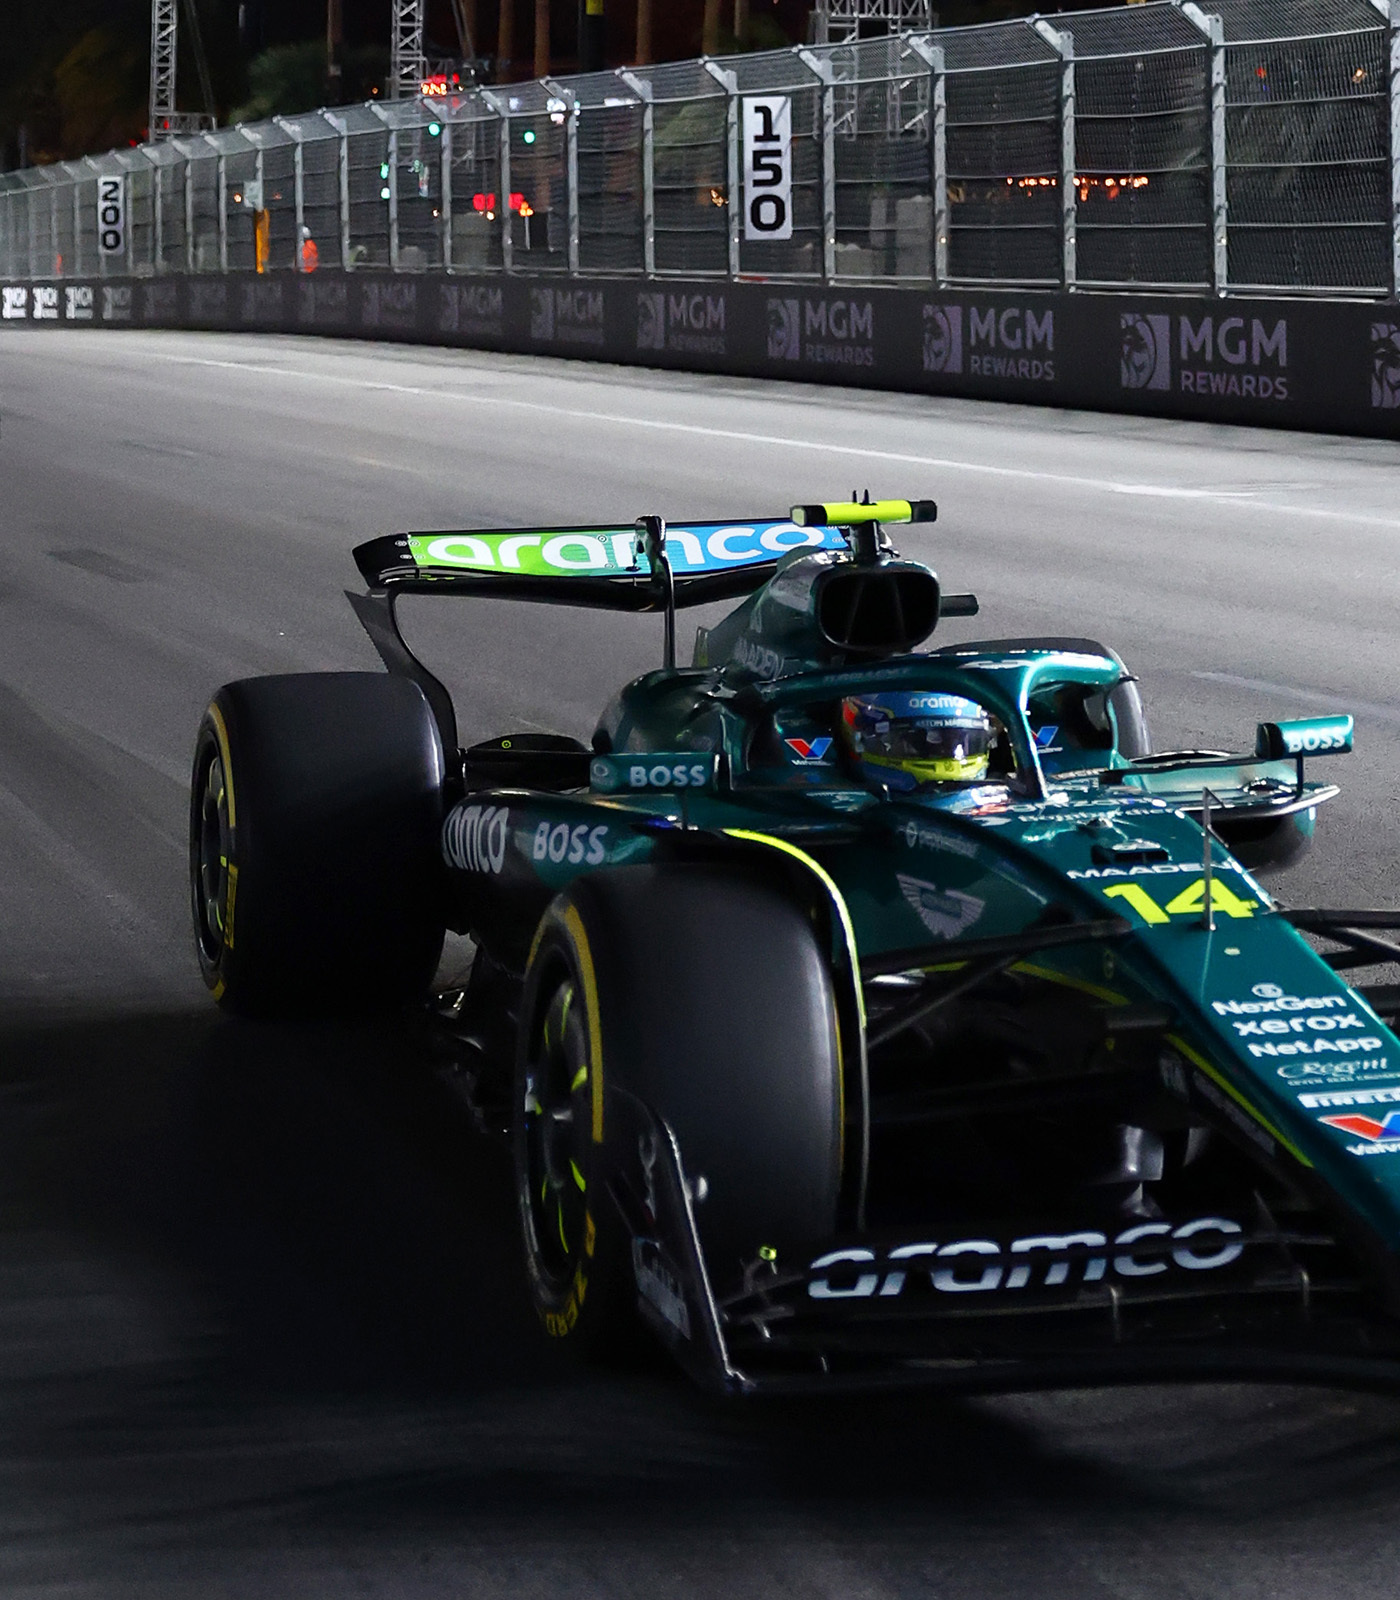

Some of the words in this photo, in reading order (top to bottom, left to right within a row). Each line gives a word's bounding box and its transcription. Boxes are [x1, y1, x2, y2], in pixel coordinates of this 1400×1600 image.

[751, 106, 786, 232] 150
[101, 181, 122, 250] 200
[668, 294, 725, 330] MGM
[805, 300, 873, 339] MGM
[969, 306, 1054, 351] MGM
[1179, 315, 1287, 367] MGM
[970, 355, 1054, 380] REWARDS
[1180, 370, 1288, 400] REWARDS
[426, 524, 825, 570] aramco
[1284, 728, 1346, 753] BOSS
[629, 765, 706, 788] BOSS
[532, 821, 609, 865] BOSS
[1102, 877, 1259, 926] 14
[1211, 995, 1347, 1016] NexGen
[1232, 1013, 1366, 1036] xerox
[1247, 1036, 1383, 1058] NetApp
[807, 1216, 1244, 1299] aramco
